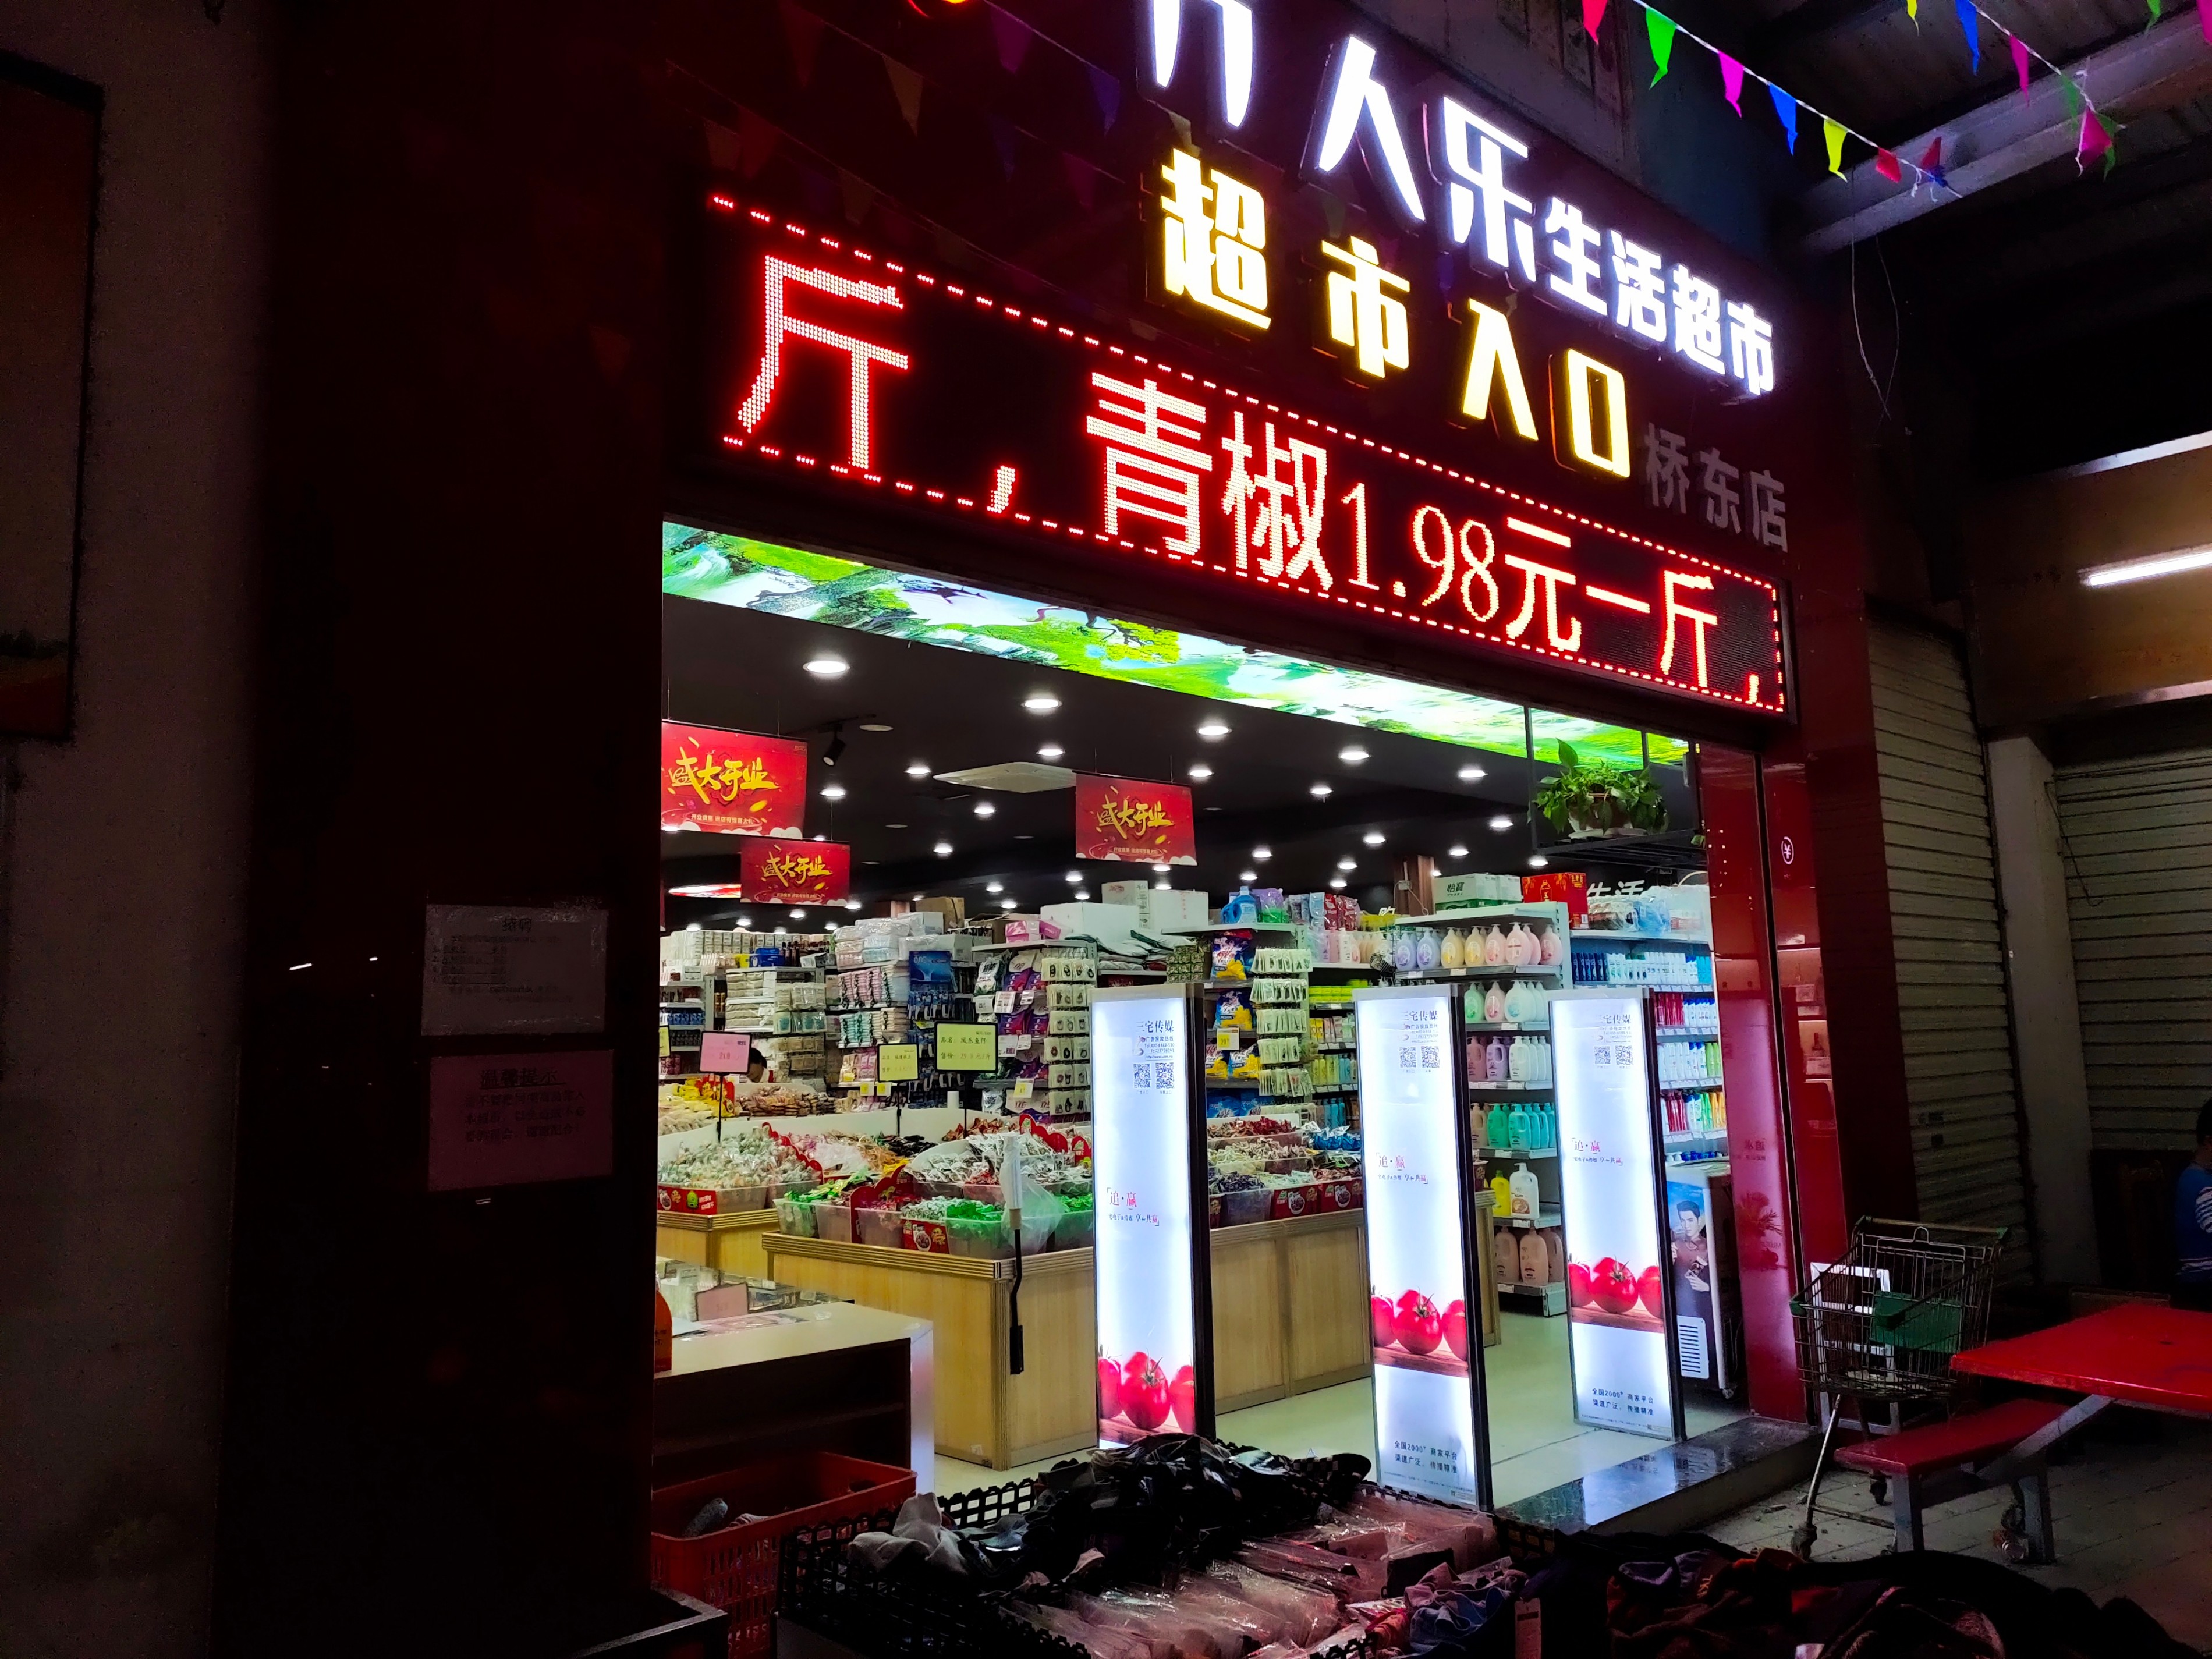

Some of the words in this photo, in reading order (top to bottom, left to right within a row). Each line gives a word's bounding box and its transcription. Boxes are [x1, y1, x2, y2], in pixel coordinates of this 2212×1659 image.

[1161, 148, 1630, 478] 超市入口
[1643, 421, 1789, 554] 桥东店
[669, 746, 781, 804] 盛大开业
[1097, 794, 1175, 840] 盛大开业
[762, 851, 833, 887] 盛大开业
[1136, 1020, 1174, 1033] 三宅传媒
[1401, 1011, 1438, 1021] 三宅传媒
[1628, 1393, 1654, 1404] 商家平台
[1430, 1447, 1458, 1461] 商家平台
